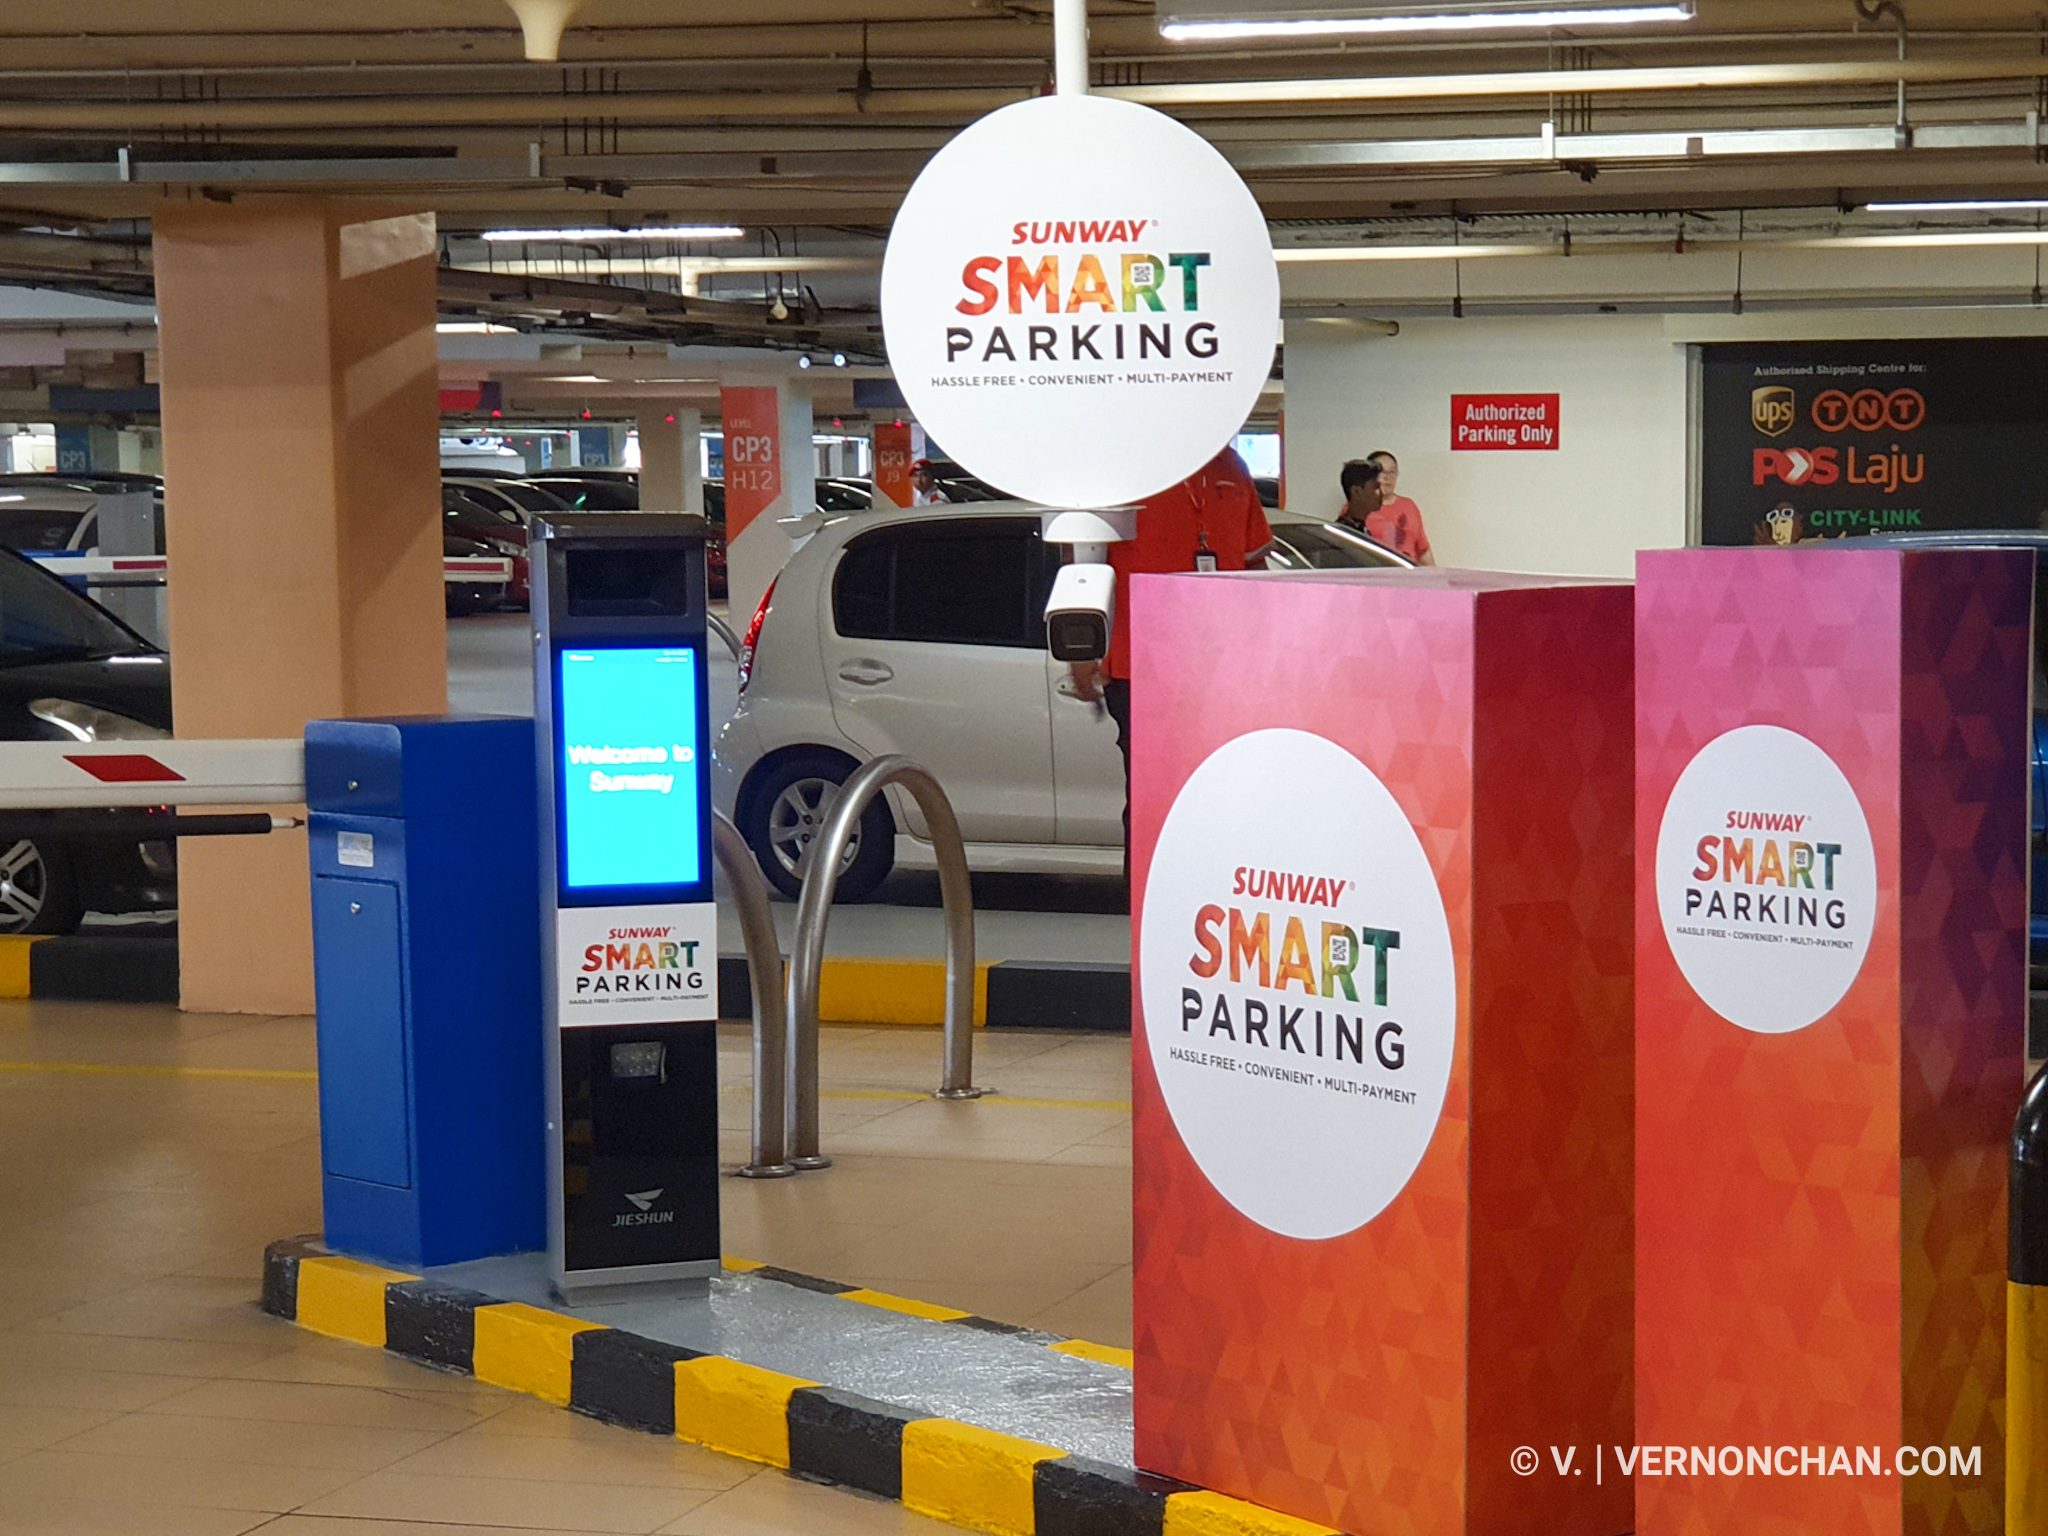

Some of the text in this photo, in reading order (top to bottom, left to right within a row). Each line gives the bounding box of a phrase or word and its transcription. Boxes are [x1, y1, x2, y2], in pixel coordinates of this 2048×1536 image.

[955, 253, 1211, 316] SMART
[947, 322, 1219, 362] PARKING
[931, 371, 1233, 387] HASSLE FREE CONVENIENT MULTI-PAYMENT
[1754, 366, 1814, 376] Authorised
[1816, 364, 1865, 376] Shipping
[1868, 363, 1906, 373] Centre
[1465, 403, 1546, 421] Authorized
[1818, 396, 1918, 425] TNT
[1458, 424, 1553, 446] Parking Only
[60, 451, 86, 469] CP3
[732, 435, 773, 463] CP3
[881, 450, 905, 467] CP3
[732, 470, 773, 490] H12
[1847, 444, 1925, 493] Laju
[1809, 508, 1922, 527] CITY-LINK
[568, 743, 694, 765] Welcome to
[589, 770, 675, 795] Sunway
[1692, 834, 1842, 891] SMART
[1686, 888, 1846, 930] PARKING
[608, 926, 671, 940] SUNWAY
[1676, 926, 1854, 950] HASSLE FREE CONVENIENT MULTI-PAYMENT
[581, 941, 700, 972] SMART
[1188, 904, 1401, 1007] SMART
[576, 972, 703, 994] PARKING
[1181, 986, 1406, 1071] PARKING
[1169, 1046, 1417, 1105] HASSLE FREE CONVENIENT MULTI-PAYMENT
[612, 1211, 674, 1227] JIESHUN
